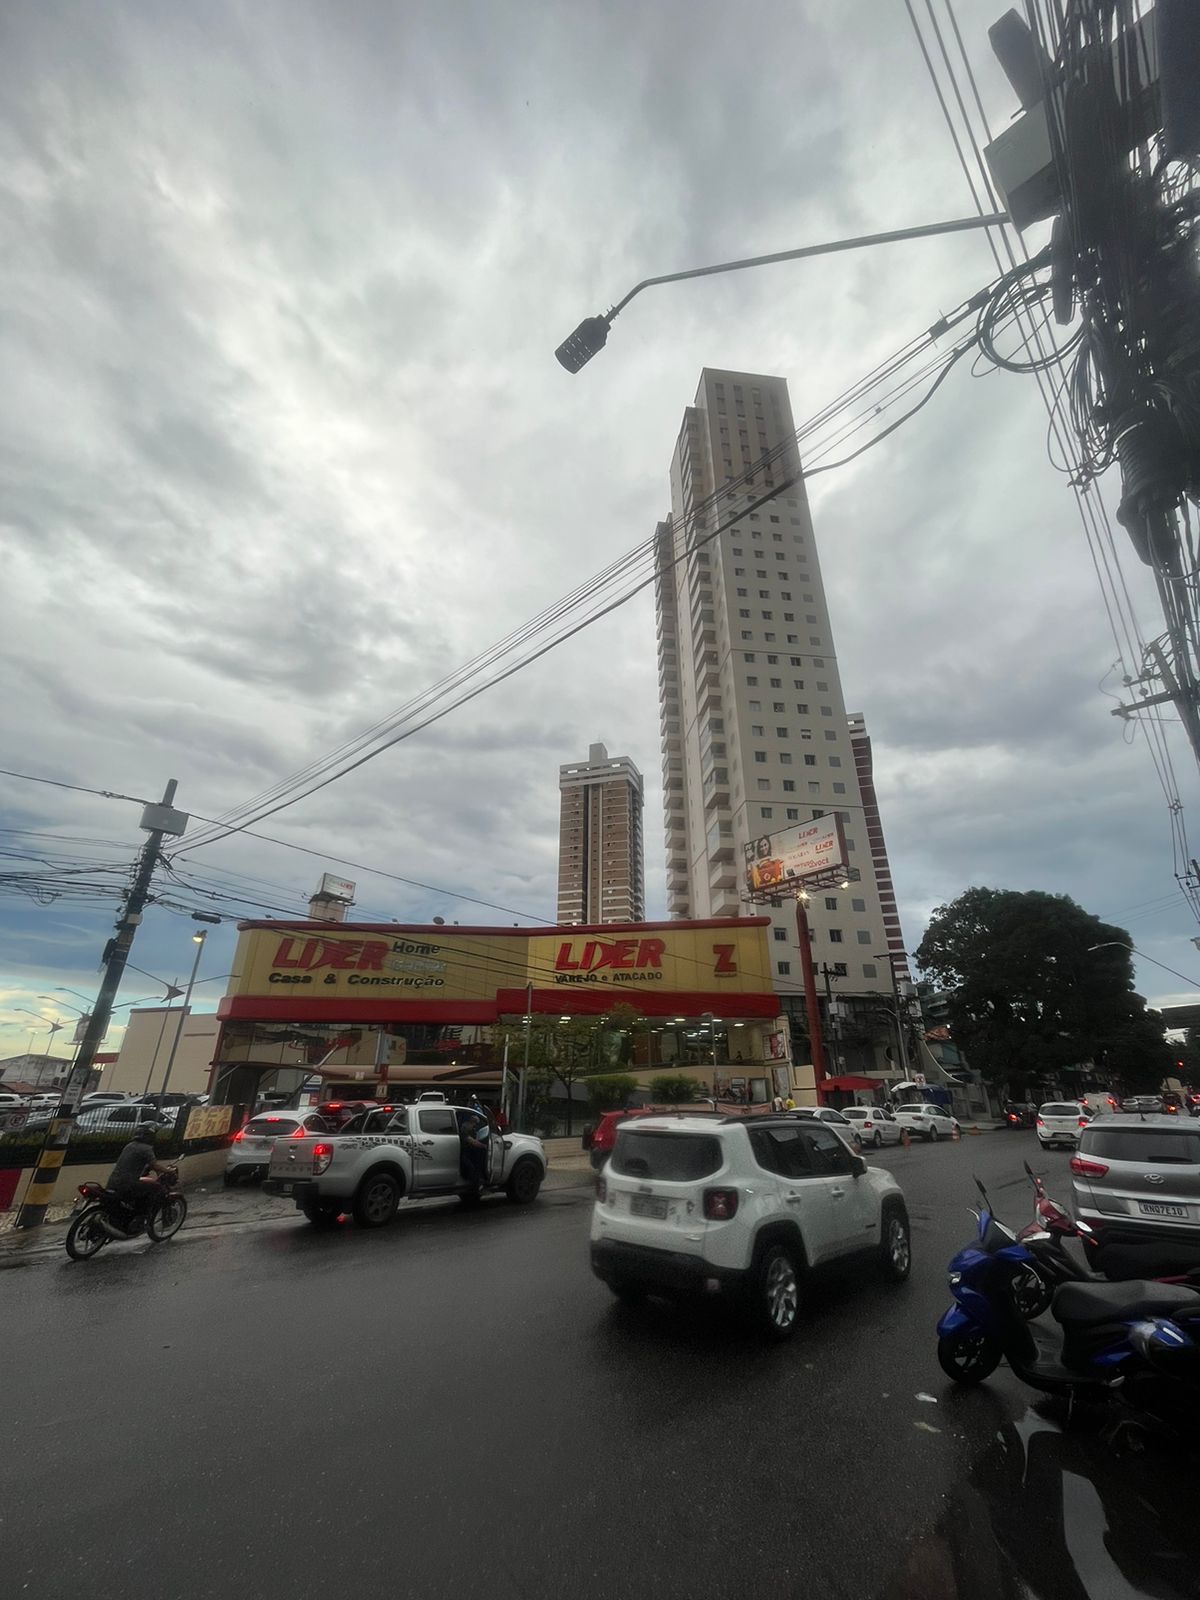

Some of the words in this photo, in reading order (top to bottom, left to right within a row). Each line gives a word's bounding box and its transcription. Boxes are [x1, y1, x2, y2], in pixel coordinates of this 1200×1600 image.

[391, 941, 441, 955] Home
[713, 944, 738, 973] Z
[268, 973, 313, 984] Casa
[323, 973, 337, 985] &
[347, 974, 445, 989] Construção
[555, 974, 597, 984] VAREJO
[612, 972, 663, 982] ATACADO
